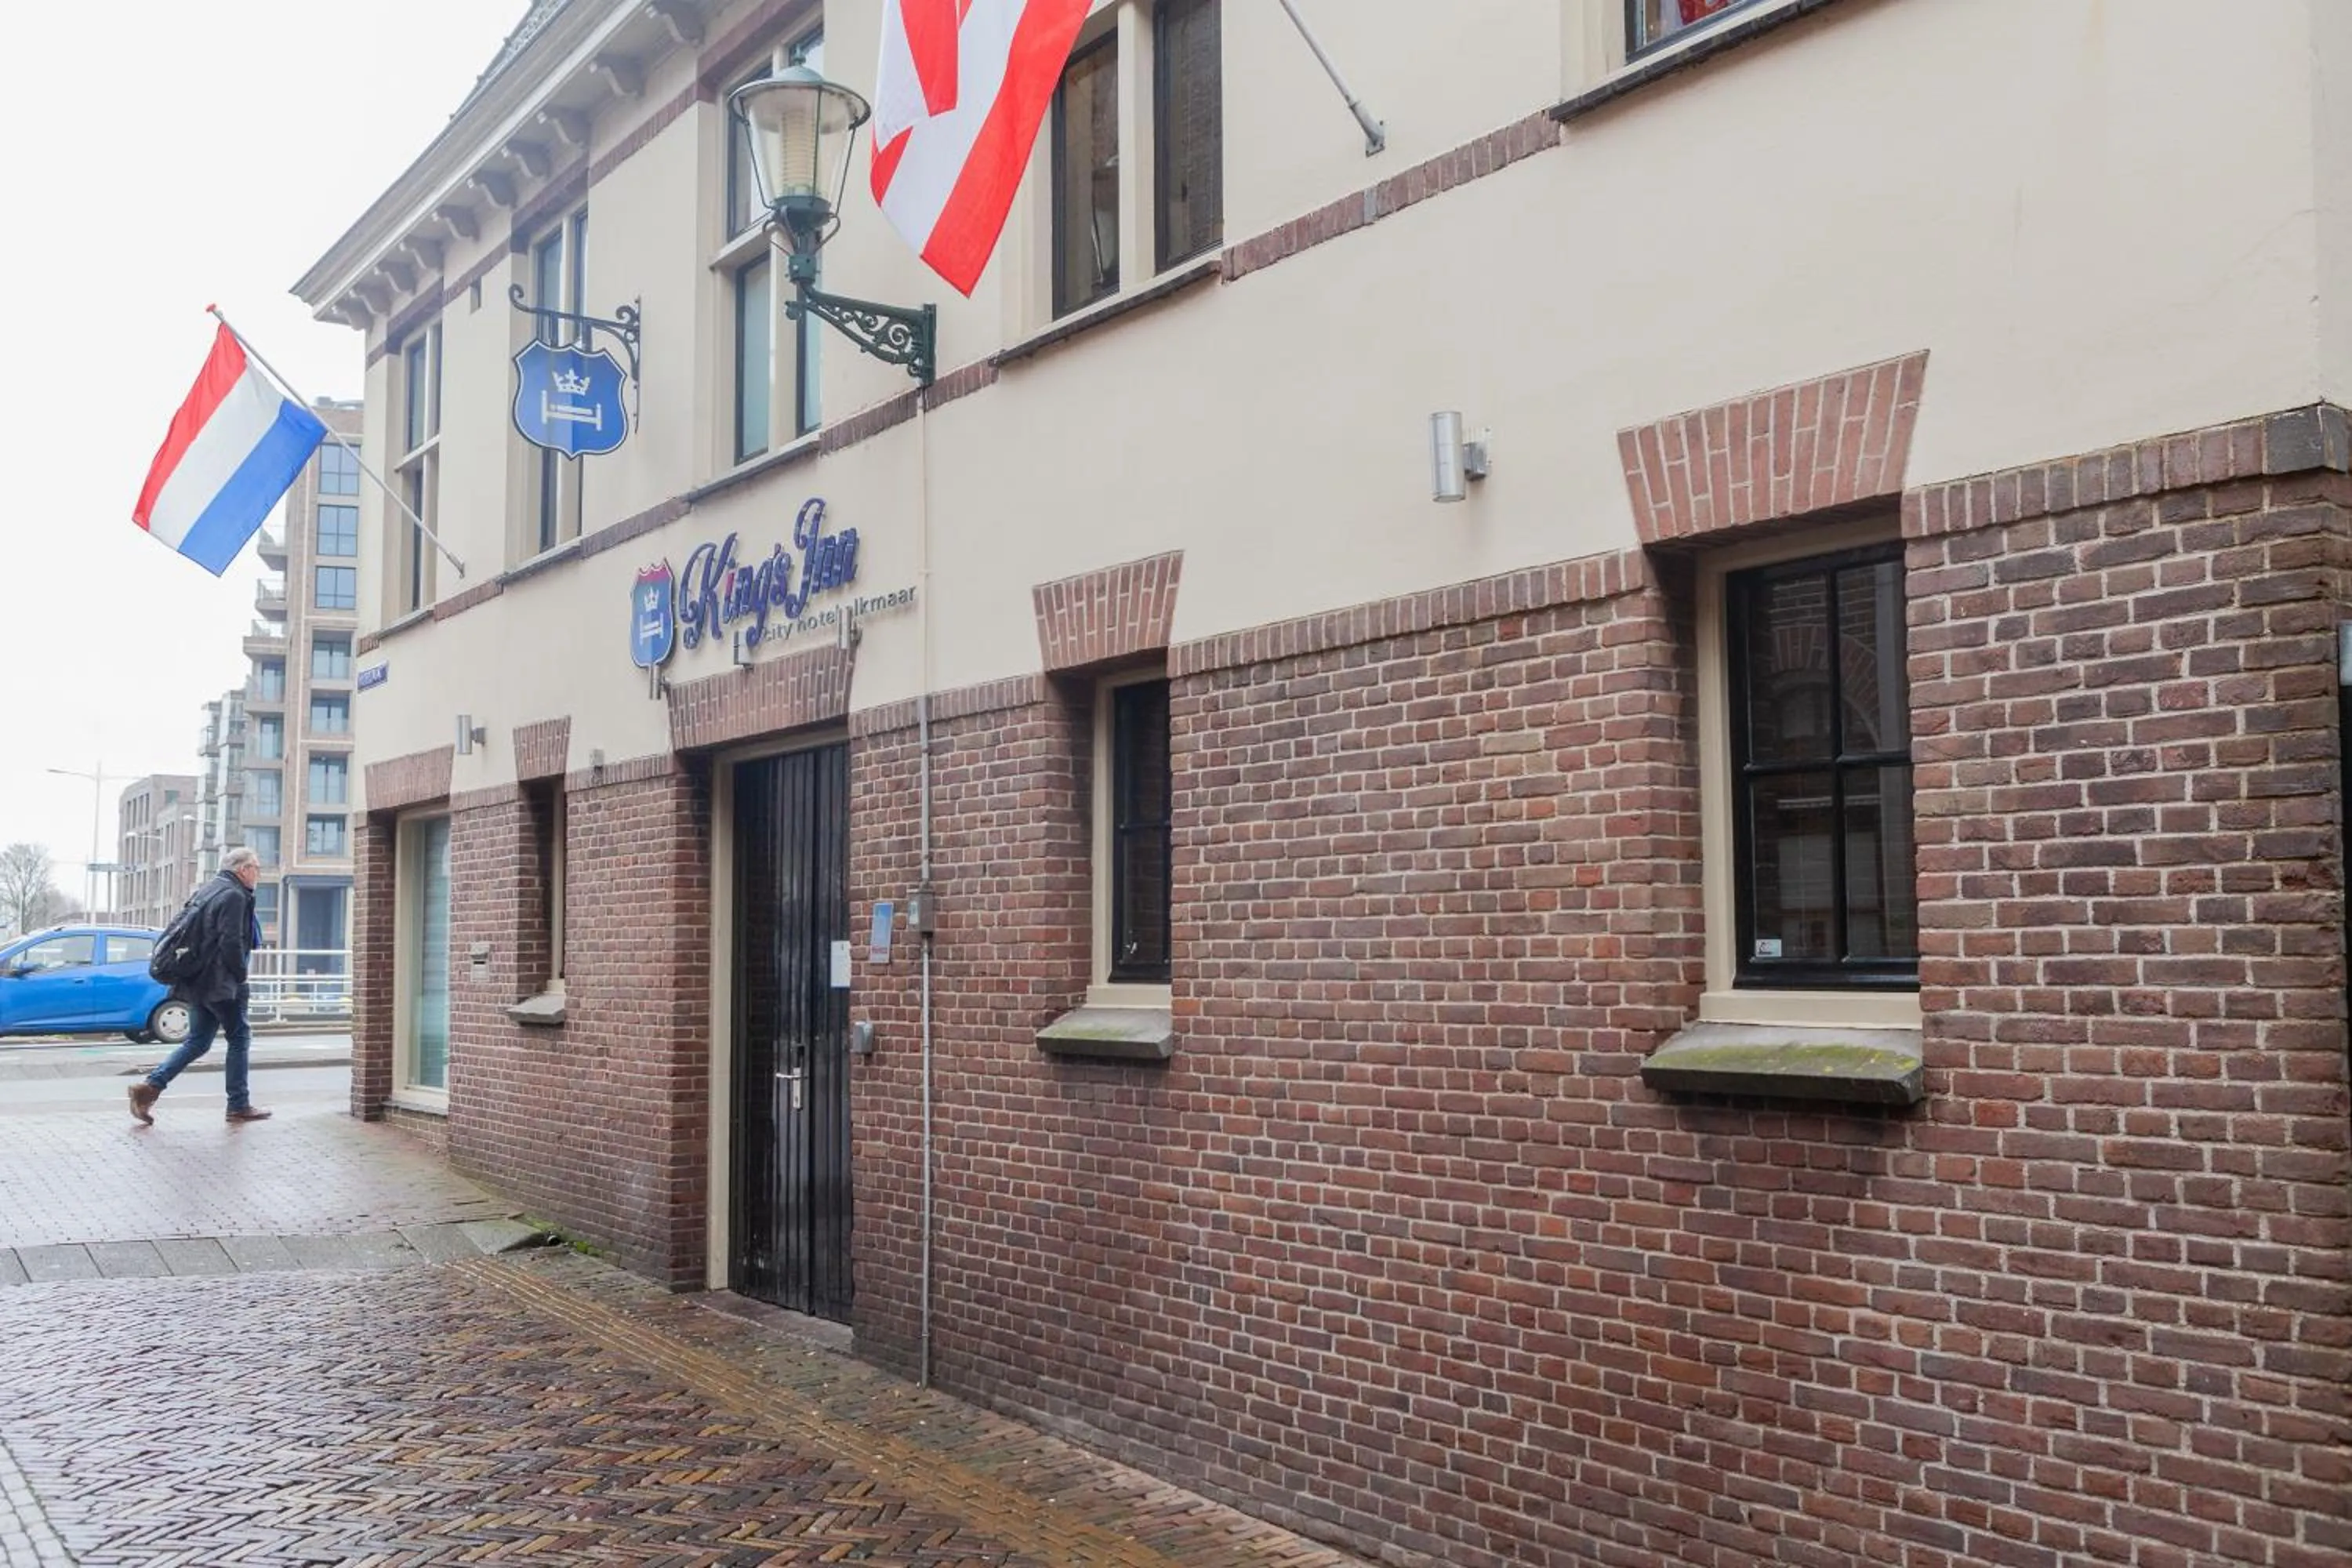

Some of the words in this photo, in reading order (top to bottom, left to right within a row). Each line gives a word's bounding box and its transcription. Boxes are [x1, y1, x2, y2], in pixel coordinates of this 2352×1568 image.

[679, 532, 791, 649] King's
[786, 497, 859, 618] Inn
[764, 623, 793, 641] city
